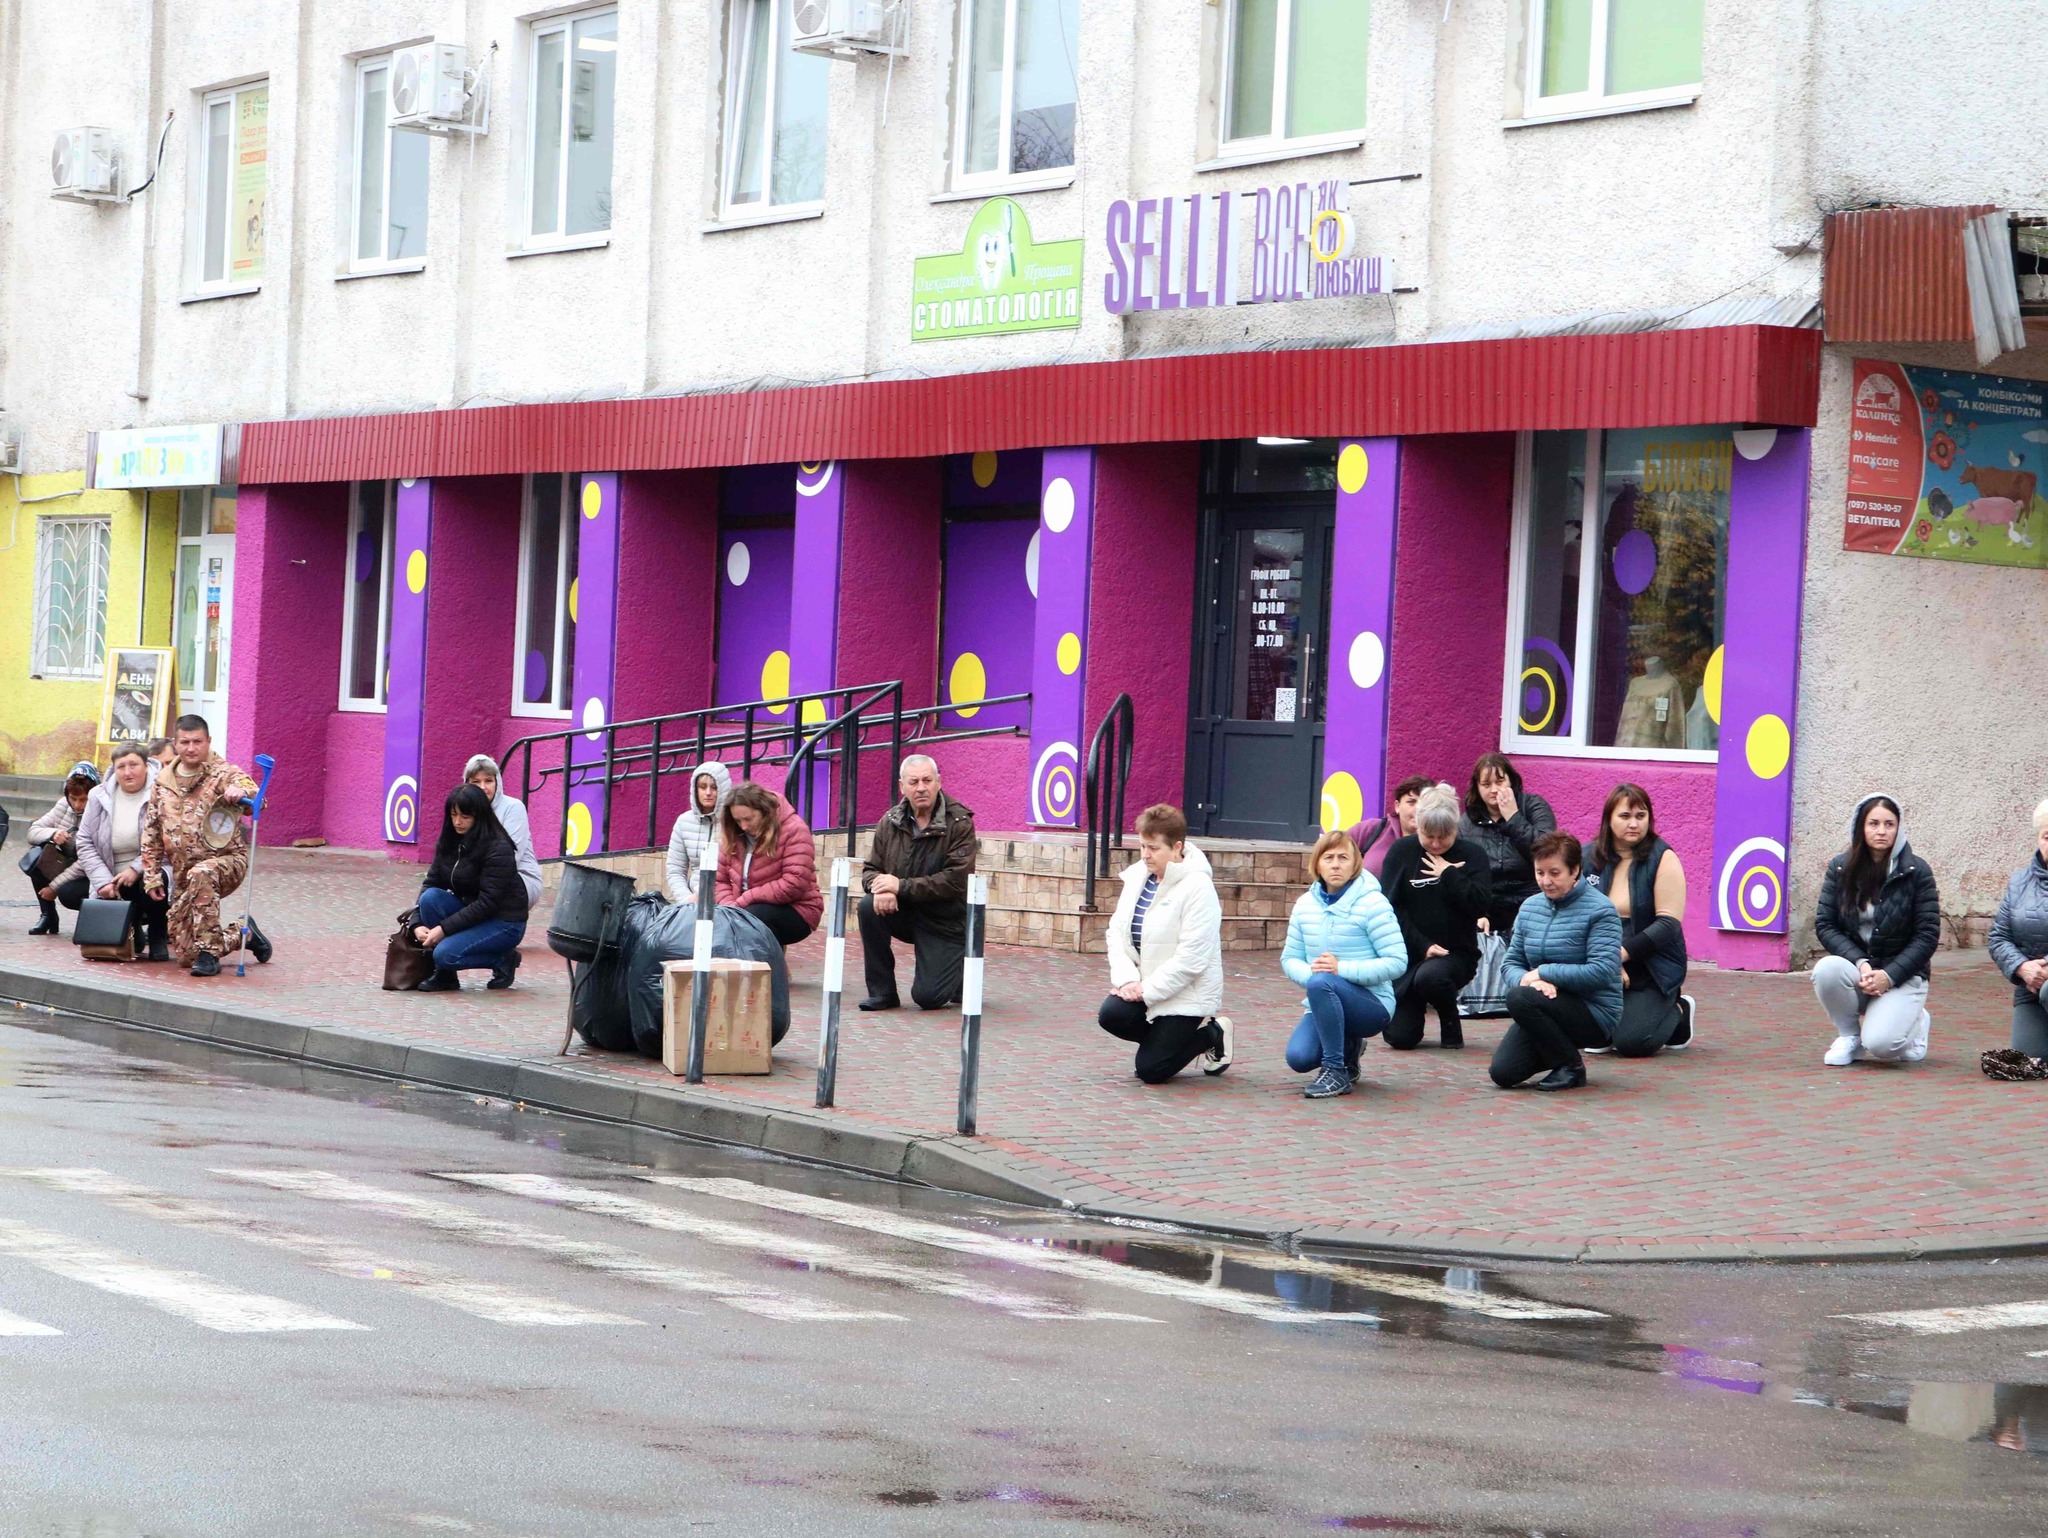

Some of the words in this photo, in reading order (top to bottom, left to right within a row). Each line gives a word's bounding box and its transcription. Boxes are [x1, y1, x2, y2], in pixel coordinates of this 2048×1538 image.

[1318, 180, 1339, 211] ЯК
[1252, 183, 1308, 302] ВСЕ
[1318, 219, 1338, 252] ТИ
[1104, 191, 1231, 315] SELLI
[1315, 257, 1381, 298] ЛЮБИШ
[914, 288, 1078, 332] СТОМАТОЛОГІЯ
[1978, 388, 2043, 404] КОМБІКОРМИ
[1958, 400, 1970, 409] ТА
[1972, 401, 2042, 418] КОНЦЕНТРАТИ
[1865, 432, 1898, 445] Hendrix
[1853, 452, 1899, 468] maxcare
[1848, 501, 1867, 510] (097)
[1869, 502, 1902, 513] 520-10-57
[1848, 514, 1901, 528] ВЕТАПТЕКА
[118, 673, 153, 685] ДЕНЬ
[111, 728, 146, 740] КАВИ
